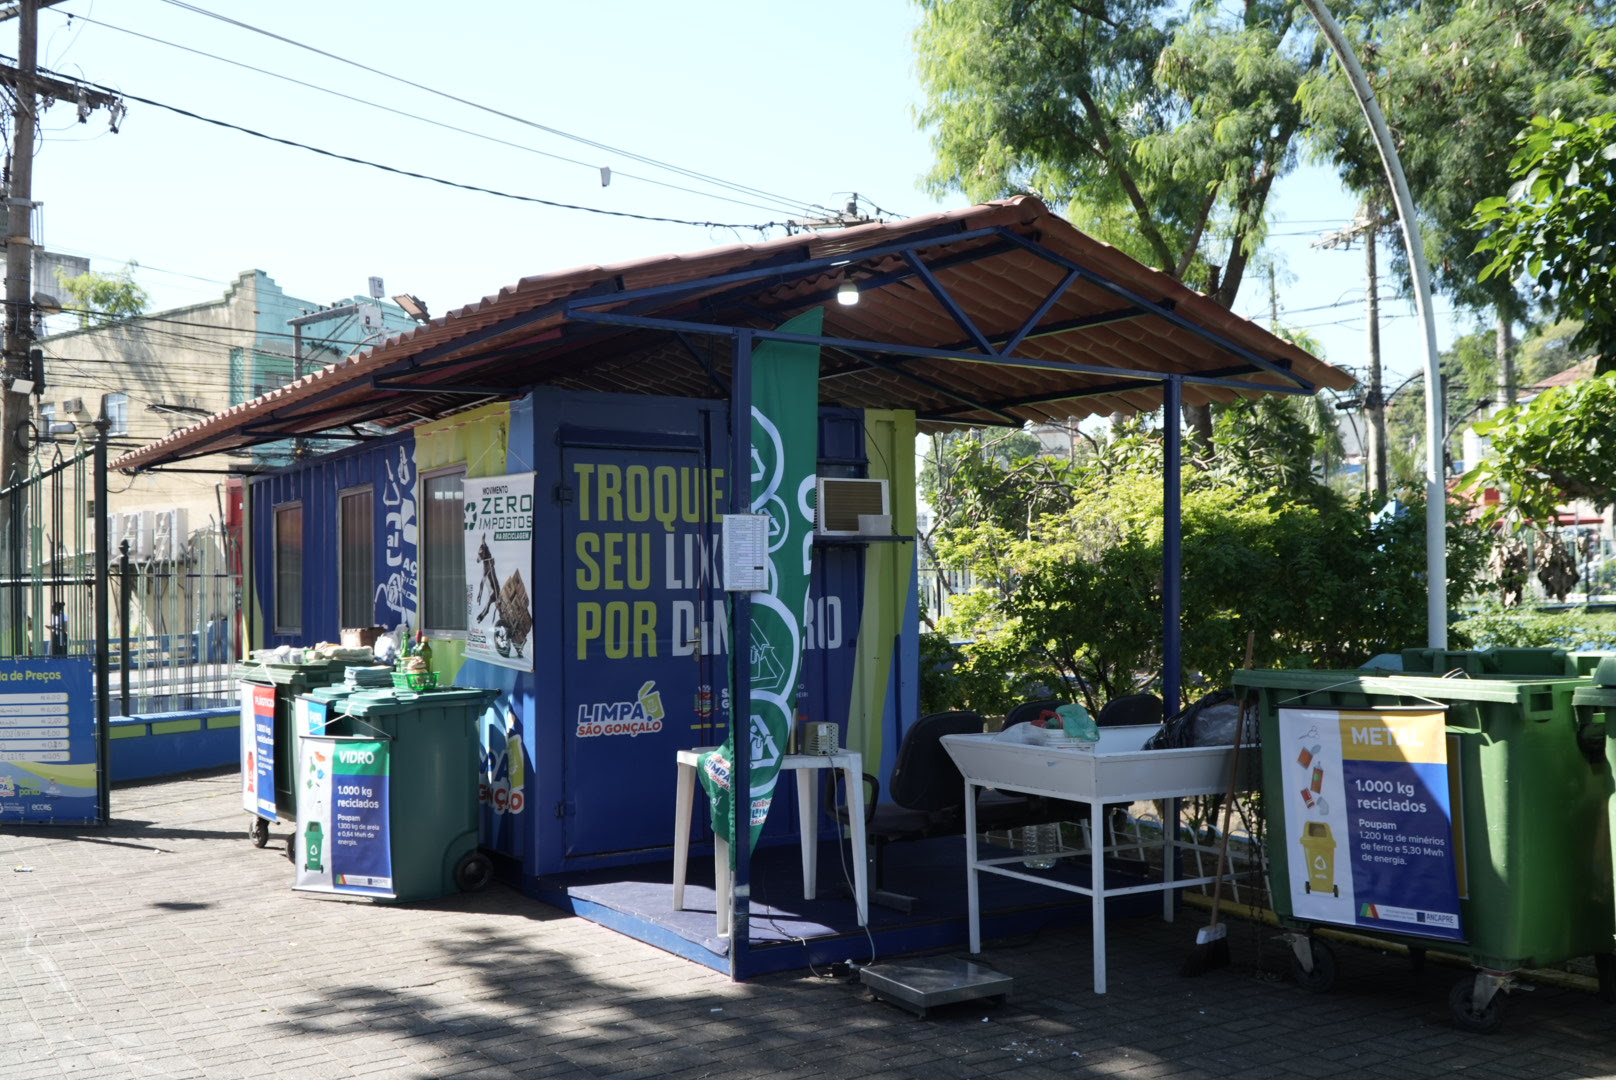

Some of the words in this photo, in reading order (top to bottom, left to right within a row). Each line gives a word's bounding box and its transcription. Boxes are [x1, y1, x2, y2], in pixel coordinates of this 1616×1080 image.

[482, 485, 508, 495] MOVIMENTO
[573, 463, 724, 531] TROQUE
[481, 494, 532, 514] ZERO
[479, 516, 532, 530] IMPOSTOS
[575, 532, 650, 591] SEU
[665, 533, 723, 589] LIX
[577, 601, 657, 660] POR
[672, 596, 842, 656] DINRO
[10, 670, 23, 681] de
[25, 670, 61, 683] Preços
[579, 702, 645, 723] LIMPA
[578, 722, 602, 736] SÃO
[604, 721, 661, 735] GONÇALO
[1351, 727, 1424, 746] METAL
[339, 751, 375, 765] VIDRO
[337, 785, 359, 796] 1.000
[361, 787, 373, 798] kg
[1355, 779, 1393, 793] 1.000
[1397, 781, 1415, 797] kg
[337, 799, 379, 809] reciclados
[1357, 797, 1427, 813] reciclados
[337, 813, 361, 822] Poupam
[1358, 818, 1397, 830] Poupam
[1359, 830, 1382, 841] 1.200
[1383, 832, 1394, 843] kg
[1395, 833, 1407, 842] de
[1408, 833, 1445, 846] minérios
[1360, 842, 1372, 851] de
[1373, 842, 1393, 852] ferro
[1402, 845, 1422, 856] 5,30
[1423, 848, 1444, 857] Mwh
[1361, 852, 1373, 862] de
[1374, 855, 1407, 866] energia.
[1426, 912, 1454, 924] ANCAPRE
